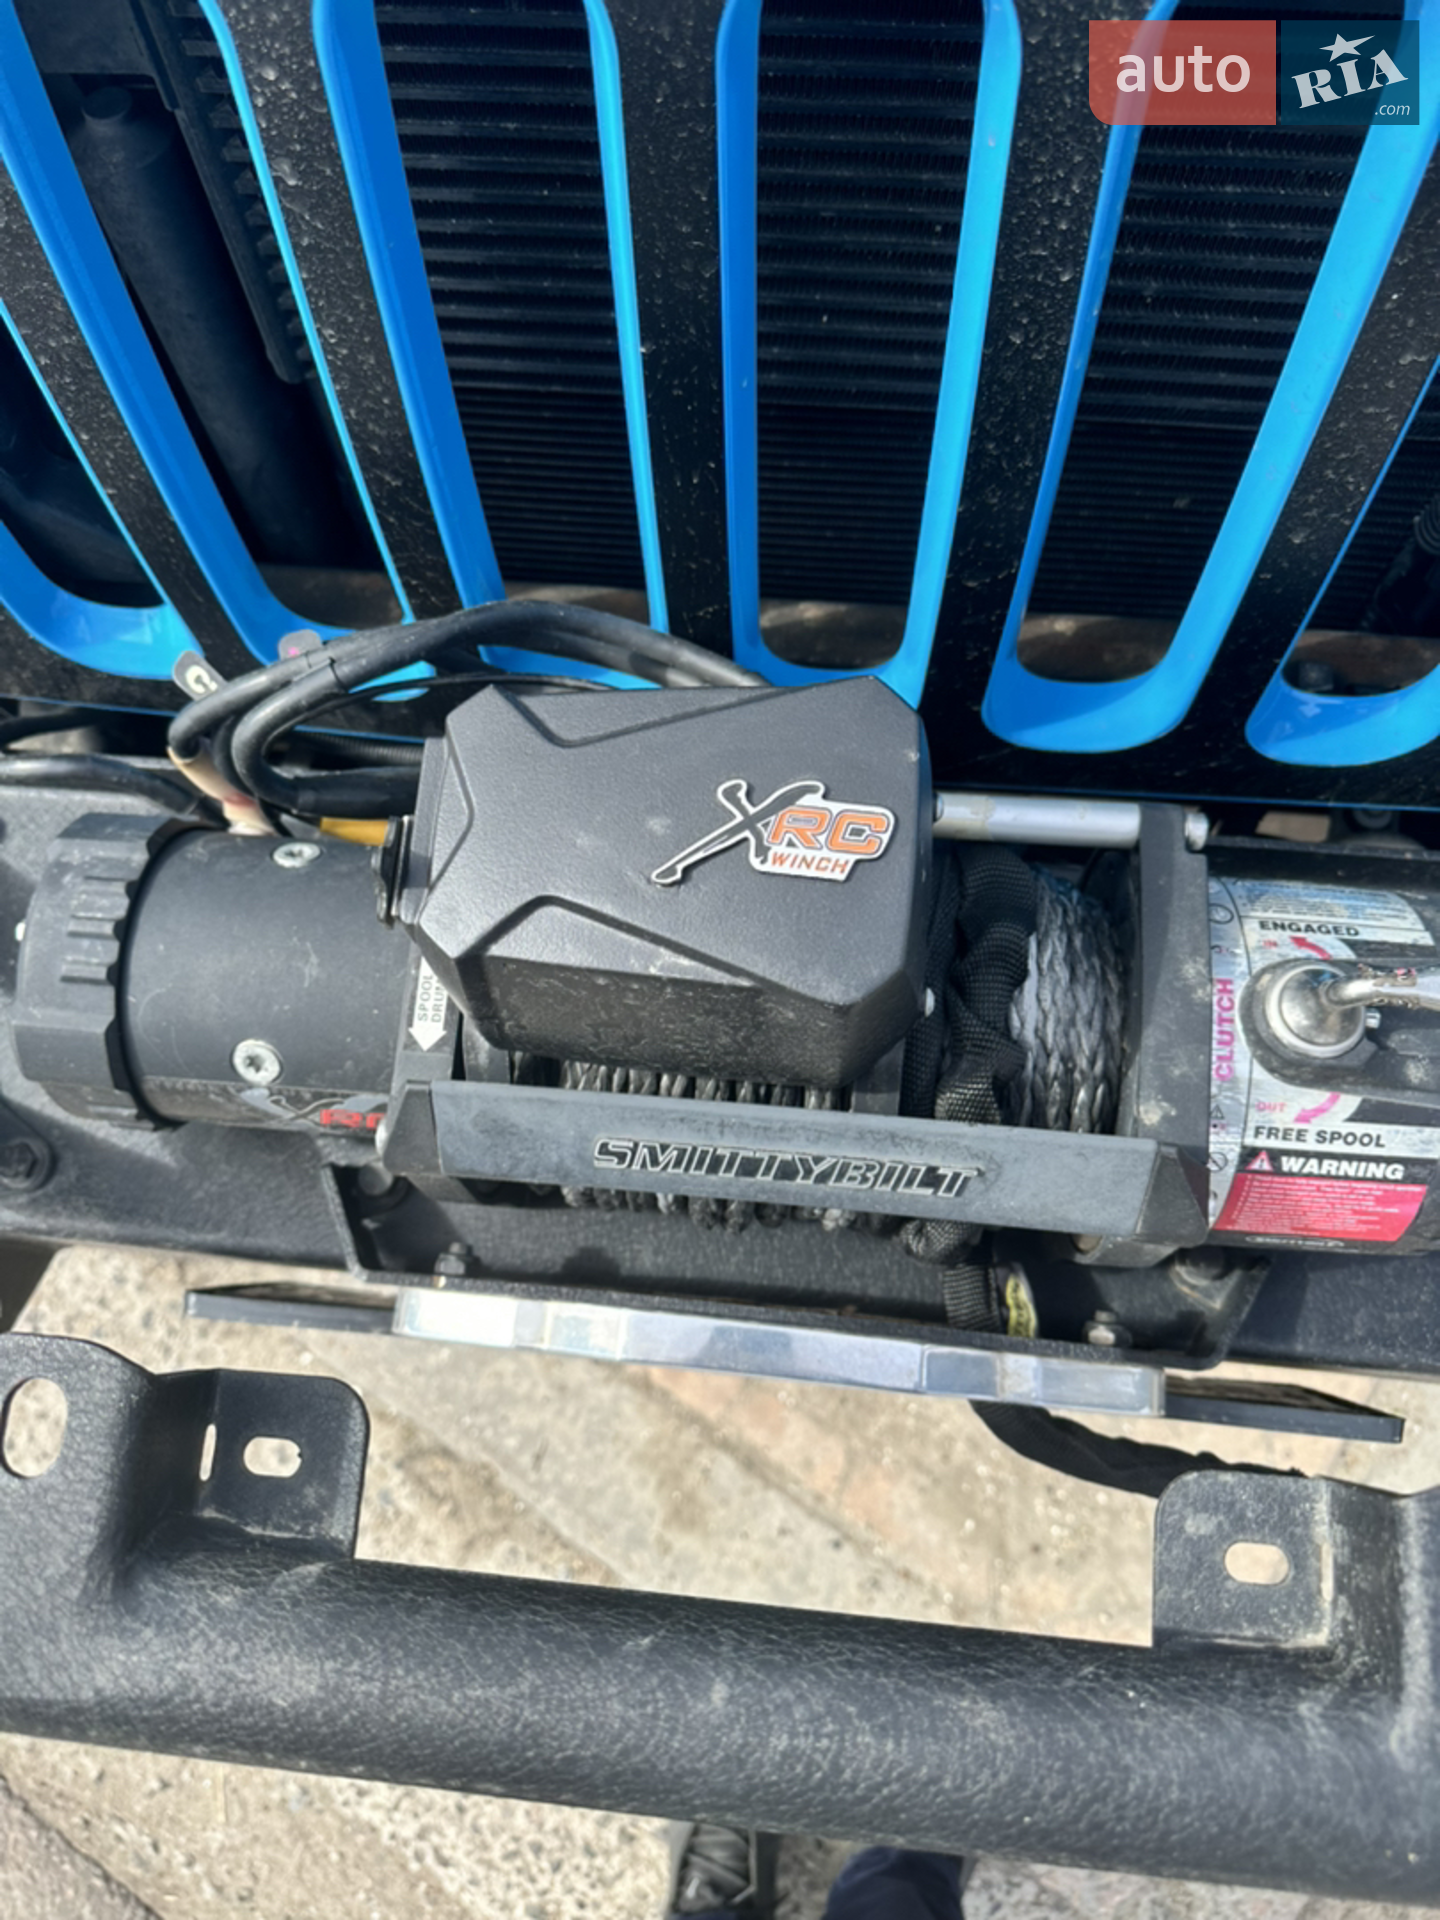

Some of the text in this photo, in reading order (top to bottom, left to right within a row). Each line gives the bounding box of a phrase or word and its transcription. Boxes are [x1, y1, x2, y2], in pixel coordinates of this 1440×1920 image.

[770, 851, 851, 875] WINCH
[1259, 920, 1360, 937] ENGAGED
[417, 974, 434, 1022] SPOOL
[1214, 977, 1235, 1082] CLUTCH
[1256, 1101, 1288, 1113] OUT
[1254, 1124, 1386, 1149] FREE SPOOL
[593, 1138, 982, 1198] SMITTYBILT
[1281, 1155, 1406, 1181] WARNING
